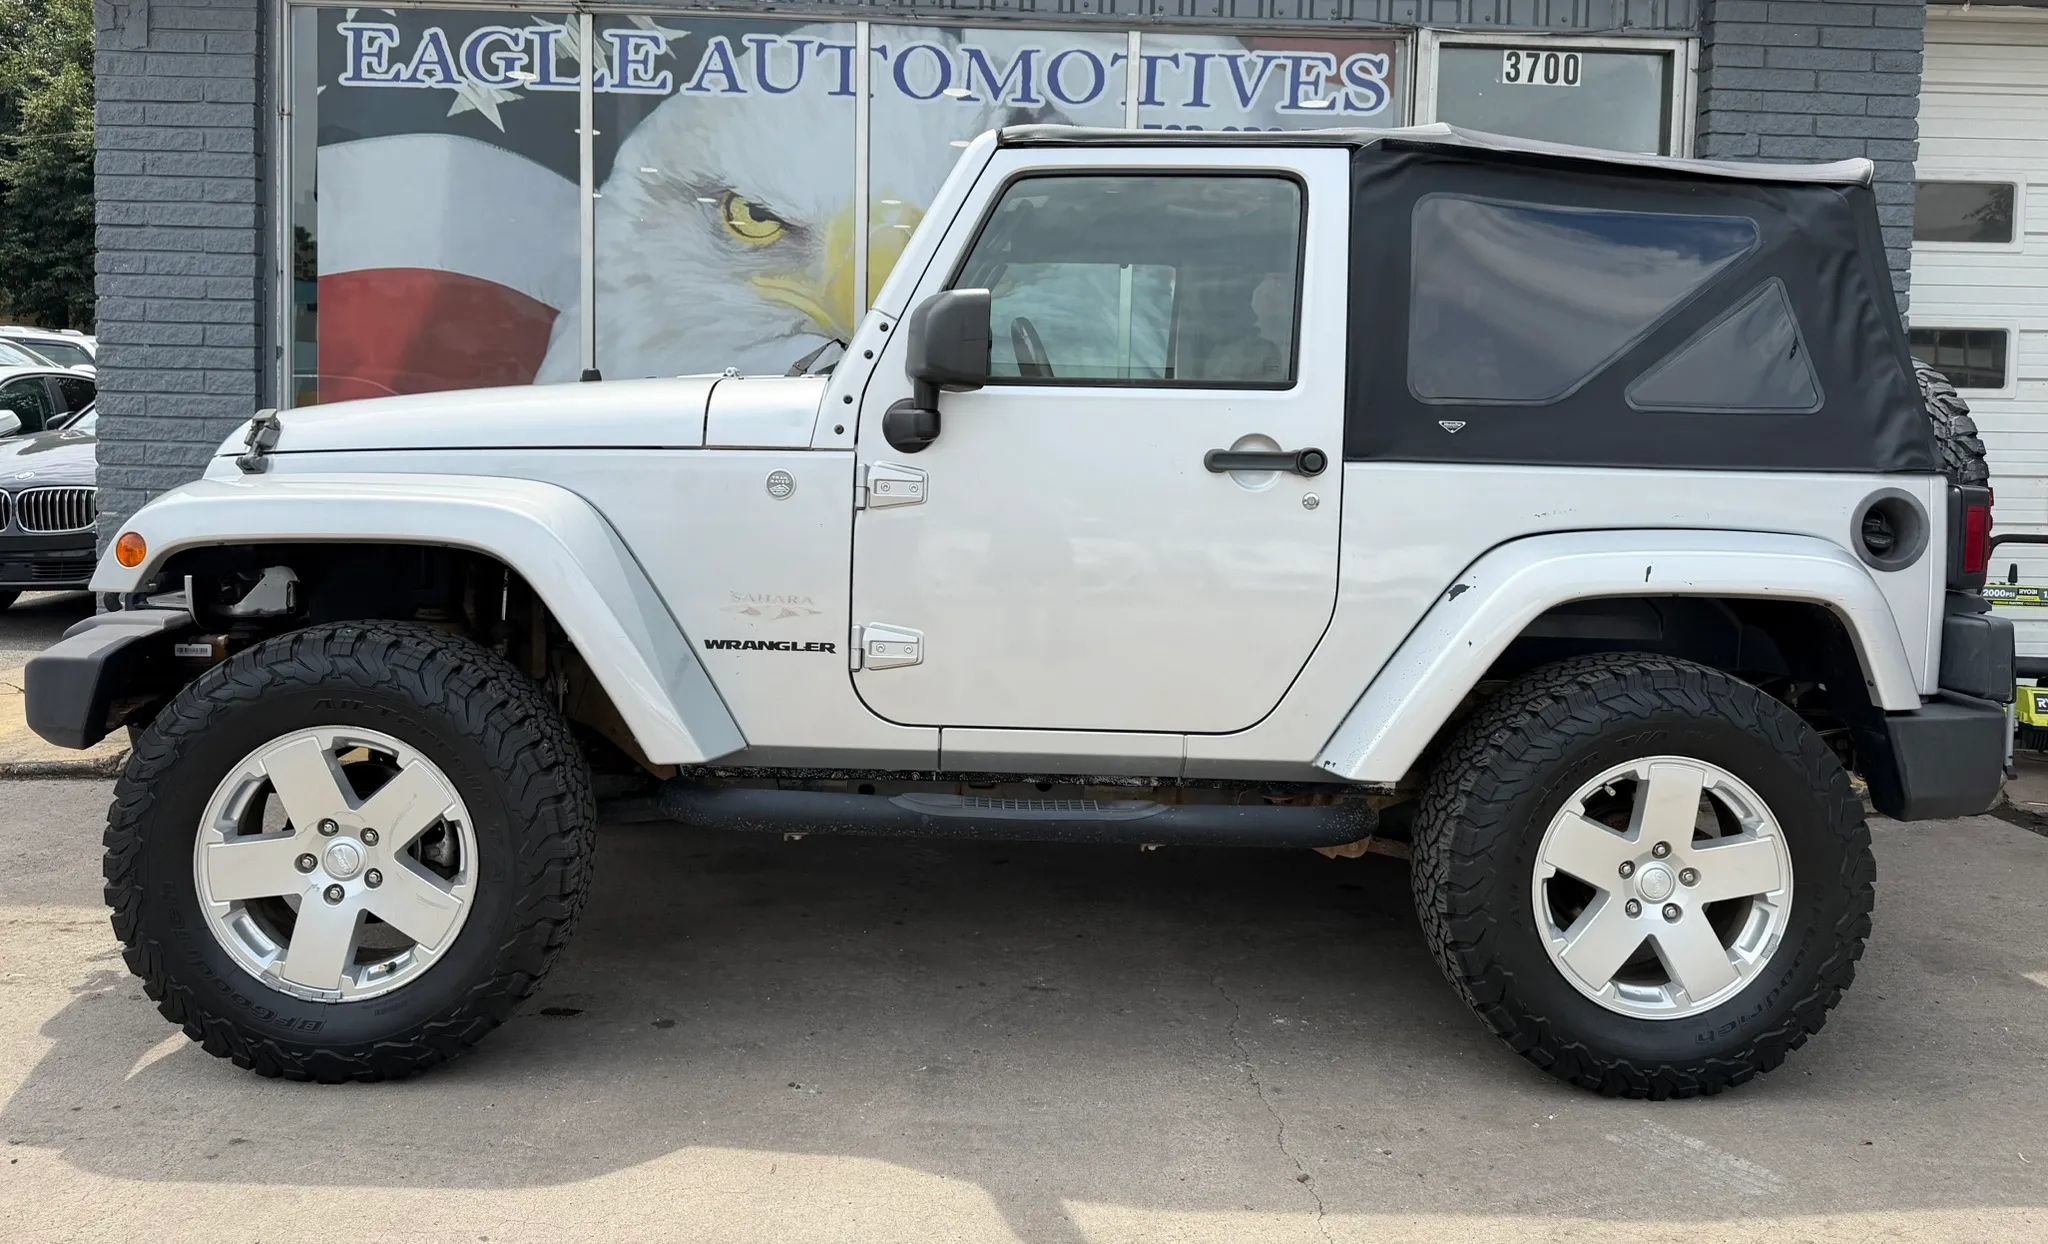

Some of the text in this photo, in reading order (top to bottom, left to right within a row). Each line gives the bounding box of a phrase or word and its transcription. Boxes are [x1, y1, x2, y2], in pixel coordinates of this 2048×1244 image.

[340, 24, 1388, 114] EAGLE AUTOMOTIVES
[1505, 51, 1580, 86] 3700
[730, 590, 815, 605] SAHARA
[704, 639, 837, 654] WRANGLER
